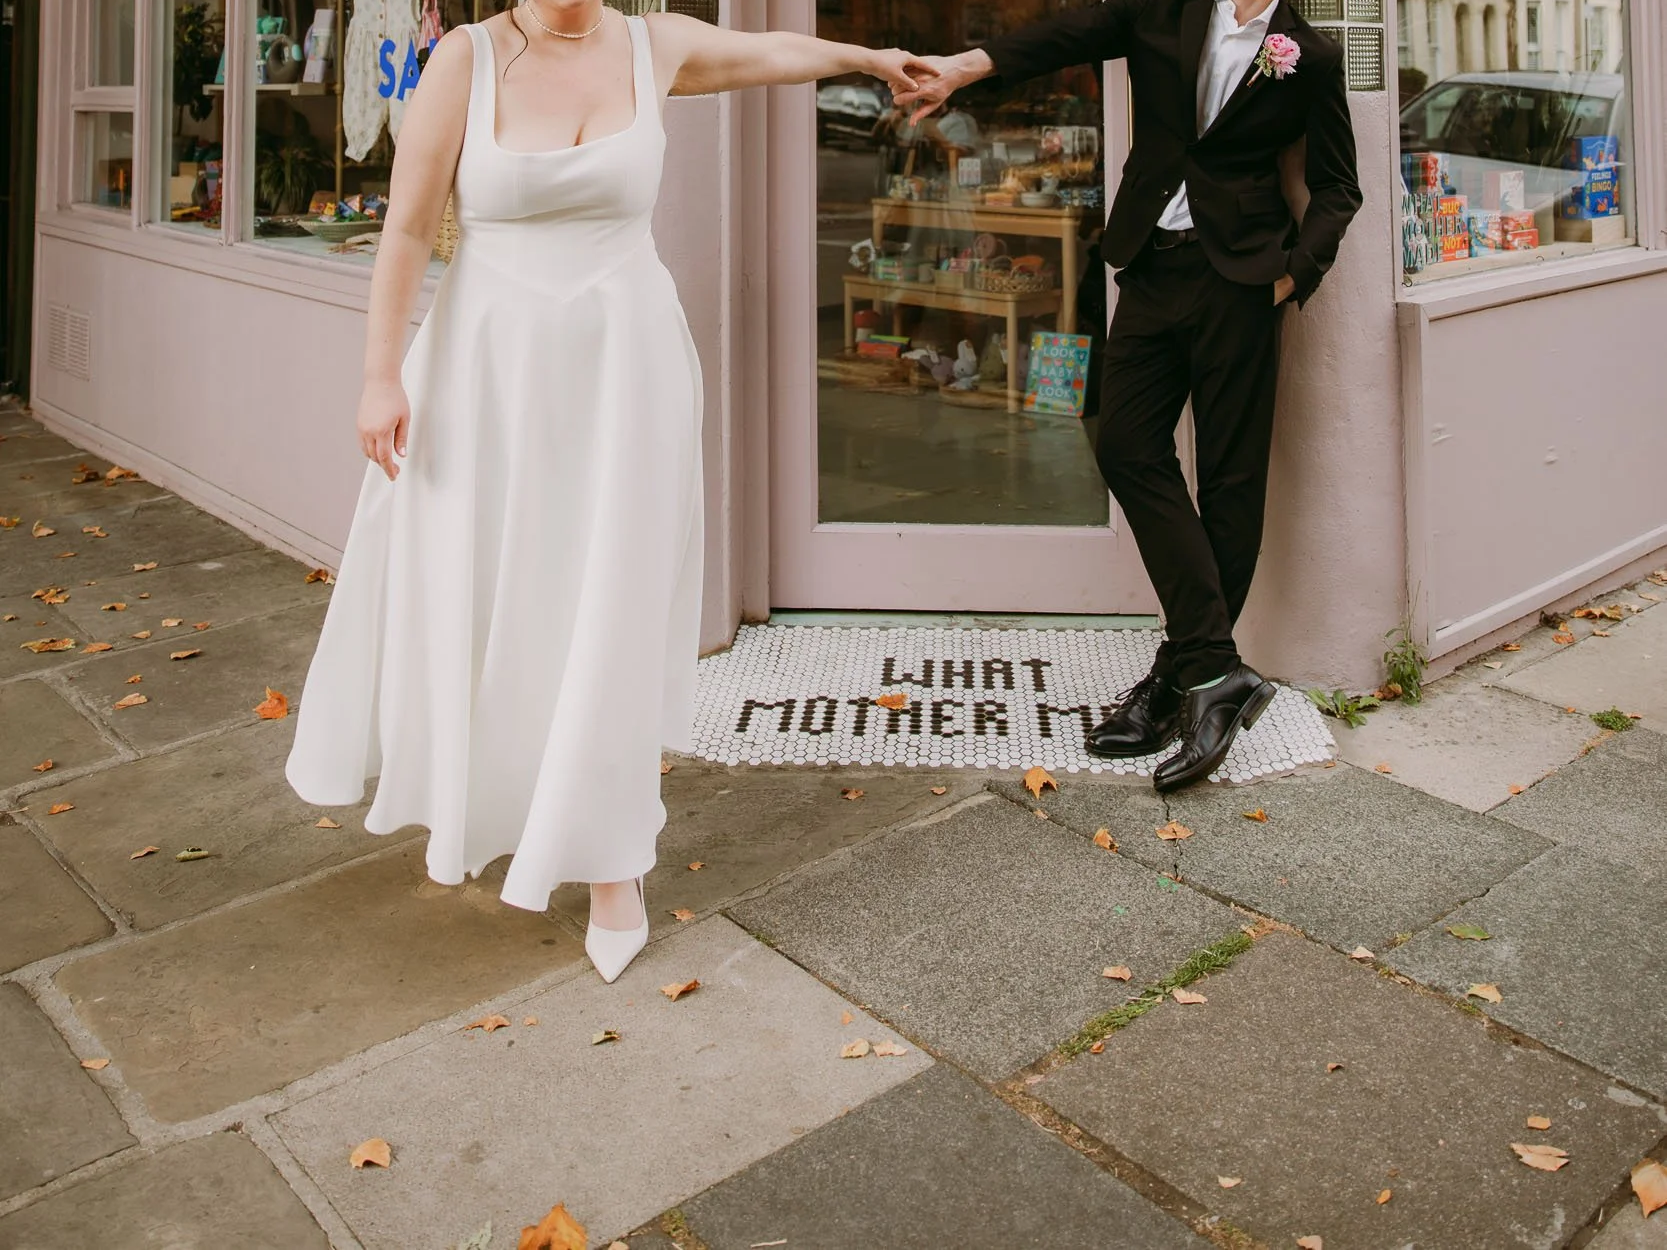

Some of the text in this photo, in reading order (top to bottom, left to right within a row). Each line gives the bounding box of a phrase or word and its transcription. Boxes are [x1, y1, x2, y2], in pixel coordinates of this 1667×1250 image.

[377, 37, 438, 102] SA
[1591, 180, 1612, 193] BINGO
[1401, 192, 1441, 215] WHAT
[1402, 214, 1463, 241] MOTHER
[1403, 237, 1444, 268] MADE
[1043, 347, 1075, 358] LOOK
[1041, 366, 1073, 378] BABY
[1039, 387, 1071, 398] LOOK
[880, 657, 1053, 693] WHAT
[734, 696, 1010, 738] MOTHER
